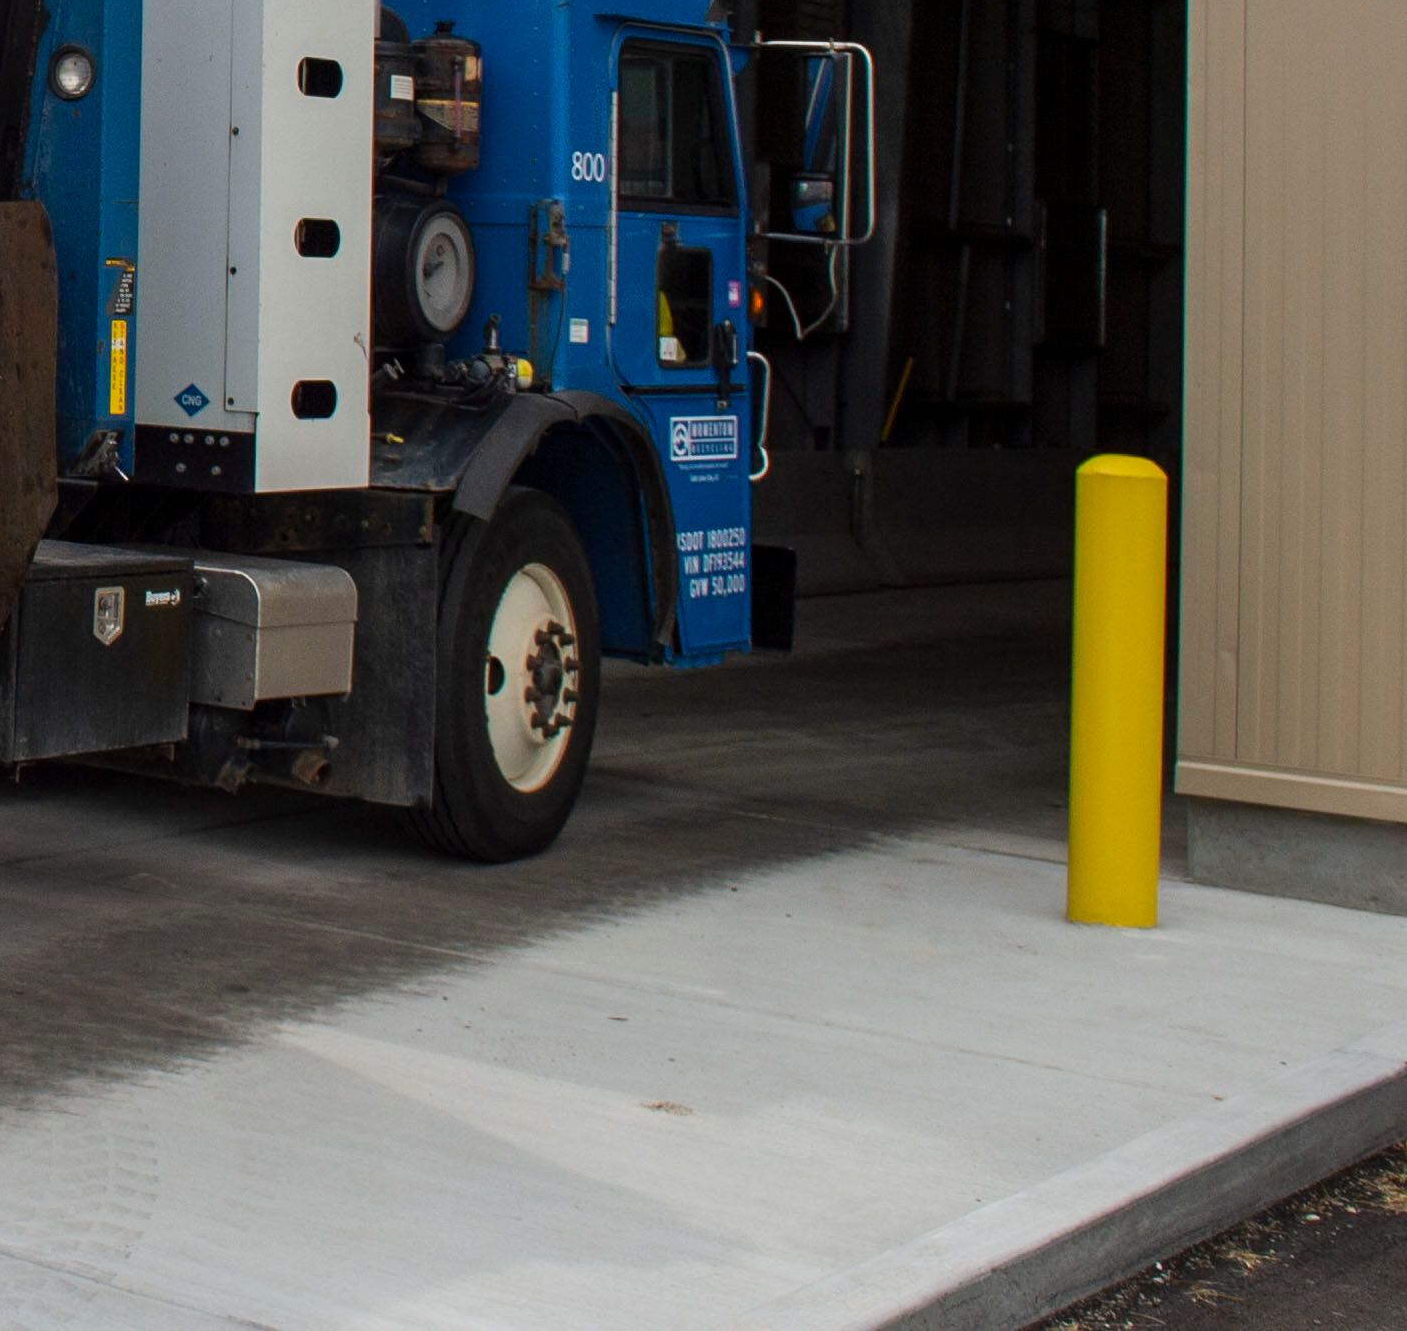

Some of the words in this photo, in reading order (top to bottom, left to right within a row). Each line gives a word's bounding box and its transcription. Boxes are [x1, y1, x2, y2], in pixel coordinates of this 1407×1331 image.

[571, 151, 605, 182] 800
[181, 394, 202, 406] CNG
[691, 422, 733, 437] MOMENTUM
[711, 573, 745, 597] 50,000
